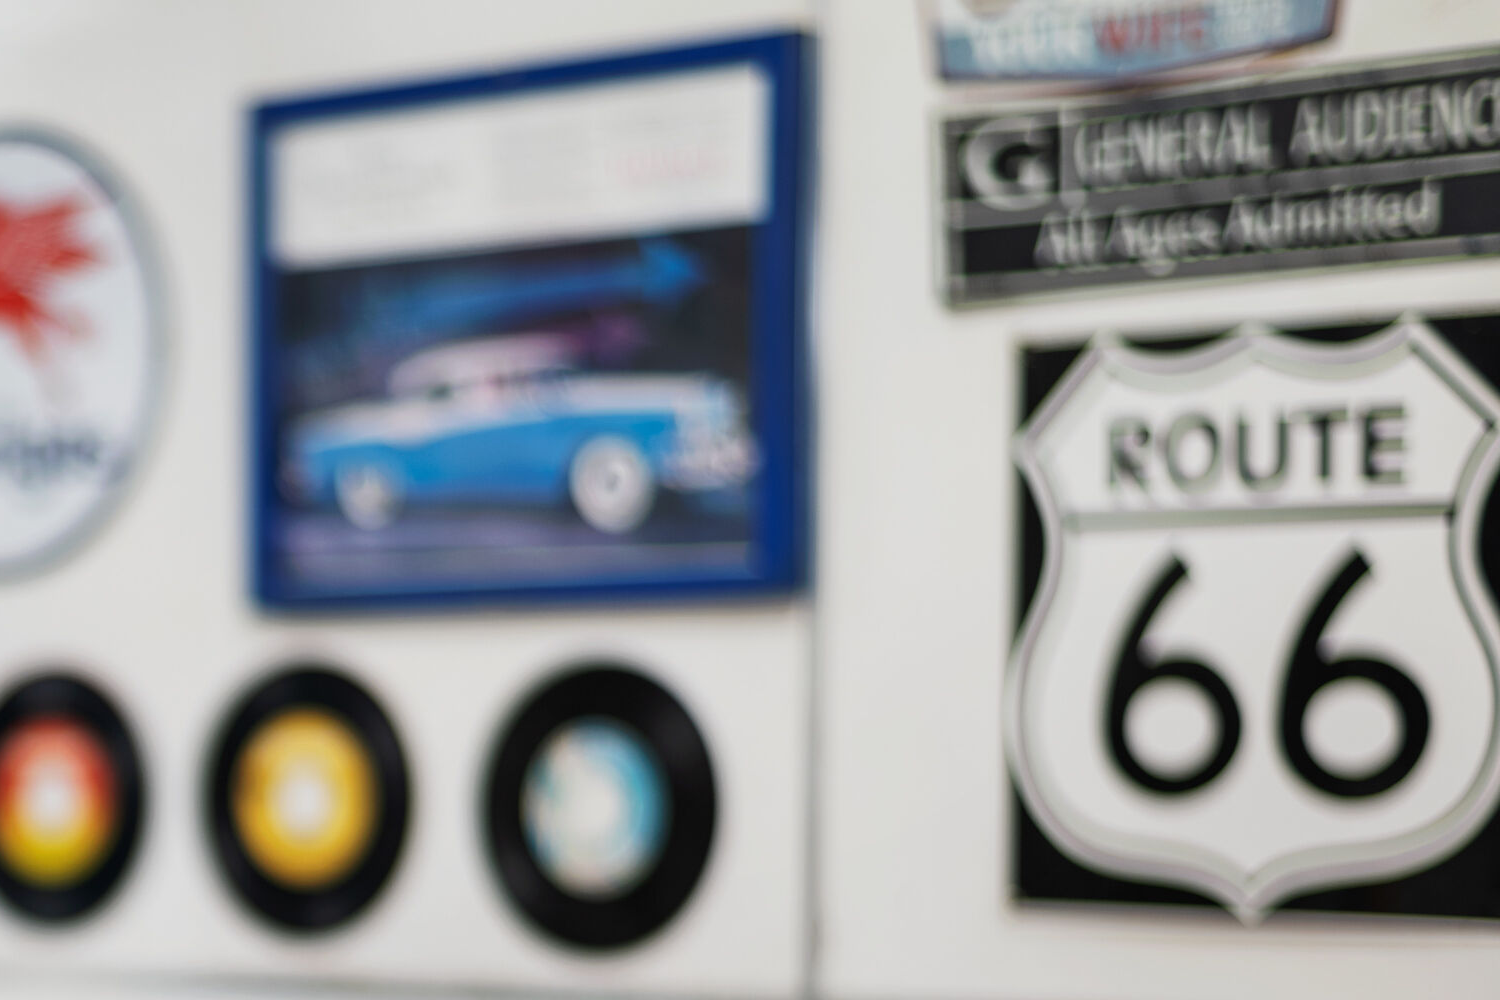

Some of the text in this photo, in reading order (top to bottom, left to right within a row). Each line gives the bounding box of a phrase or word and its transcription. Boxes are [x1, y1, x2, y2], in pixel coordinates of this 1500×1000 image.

[963, 116, 1056, 211] G
[1072, 104, 1272, 188] GENERAL
[1034, 177, 1442, 275] All Ages Admitted
[1107, 405, 1410, 498] ROUTE
[1103, 546, 1432, 799] 66
